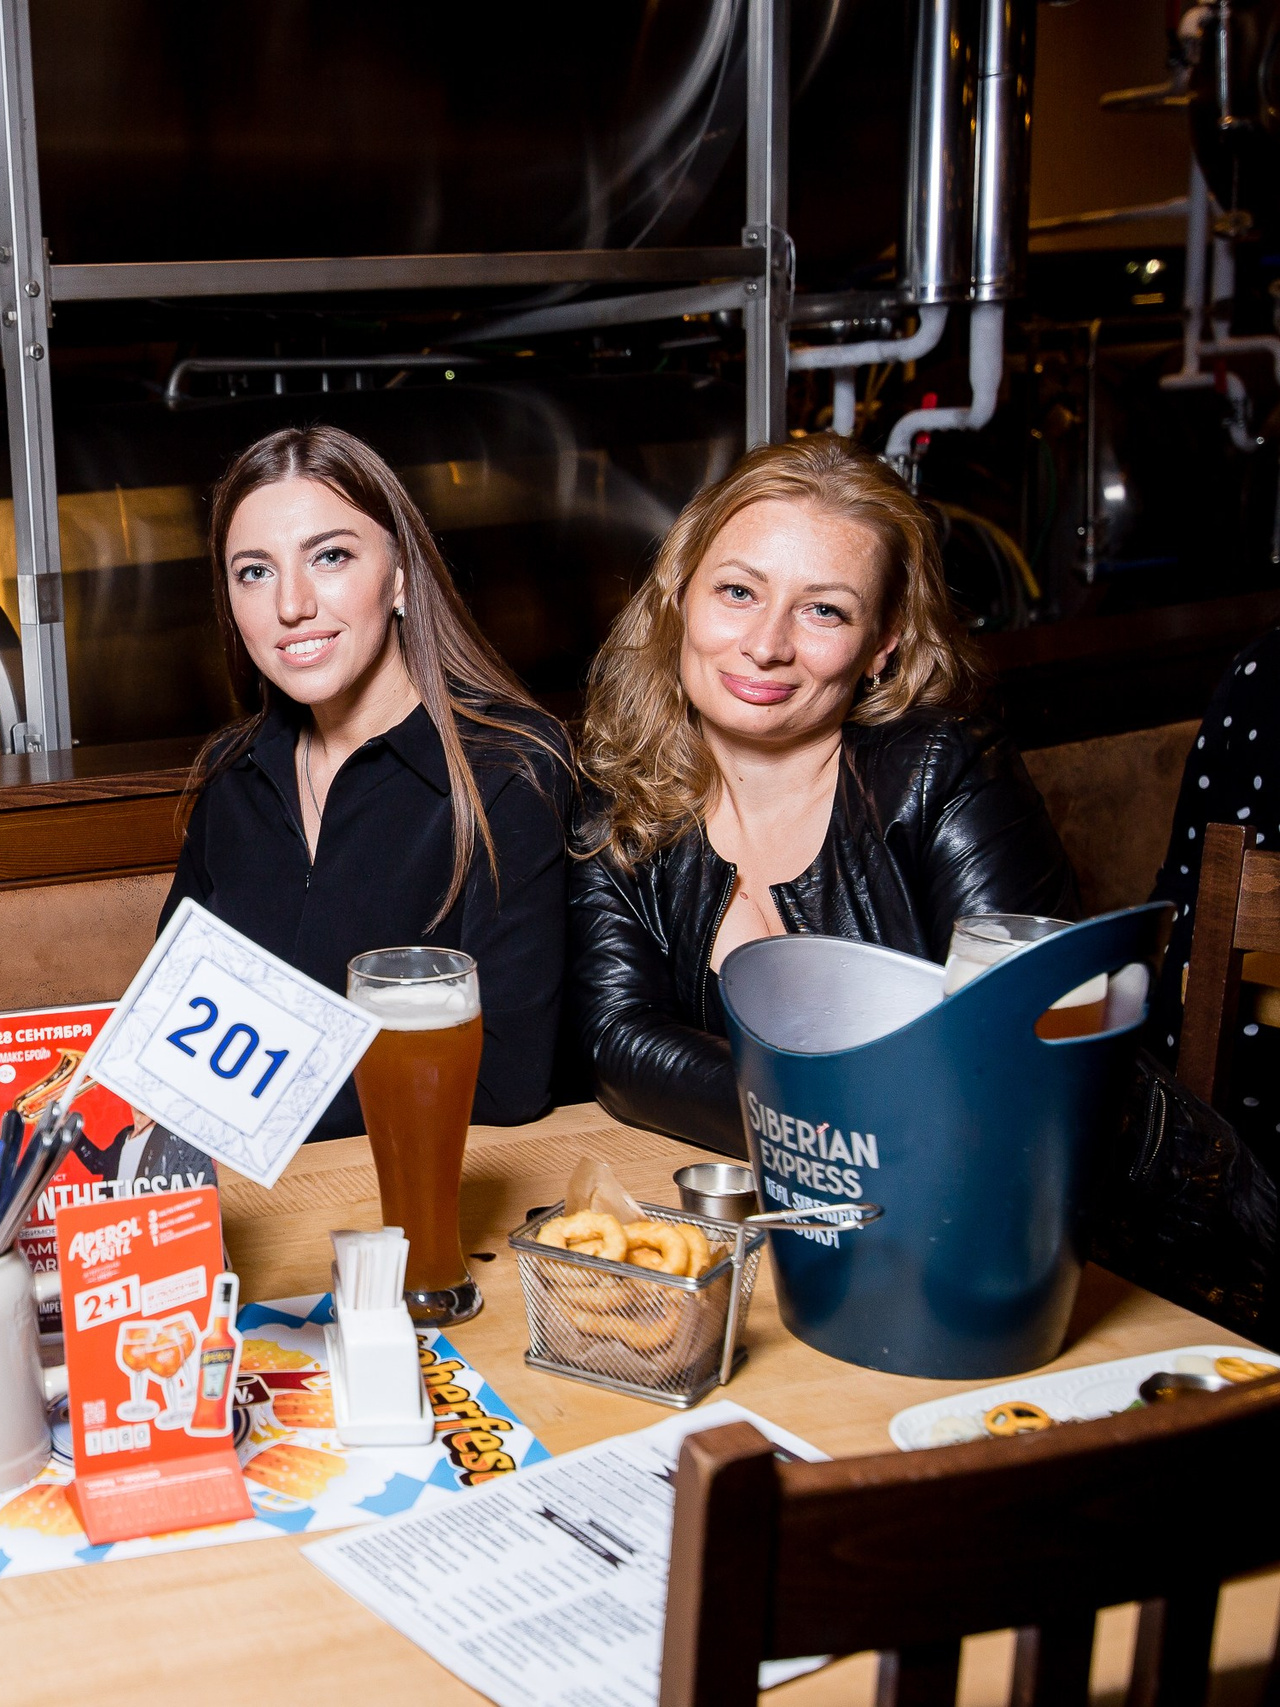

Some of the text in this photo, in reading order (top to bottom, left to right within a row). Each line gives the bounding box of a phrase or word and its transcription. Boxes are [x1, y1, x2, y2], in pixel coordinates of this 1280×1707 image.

[15, 1023, 93, 1044] СЕНТЯБРЯ
[166, 996, 291, 1099] 201
[747, 1091, 880, 1169] SIBERIAN
[759, 1138, 864, 1199] EXPRESS
[68, 1216, 143, 1262] APEROL
[81, 1238, 132, 1269] SPRITZ
[83, 1284, 132, 1322] 2+1
